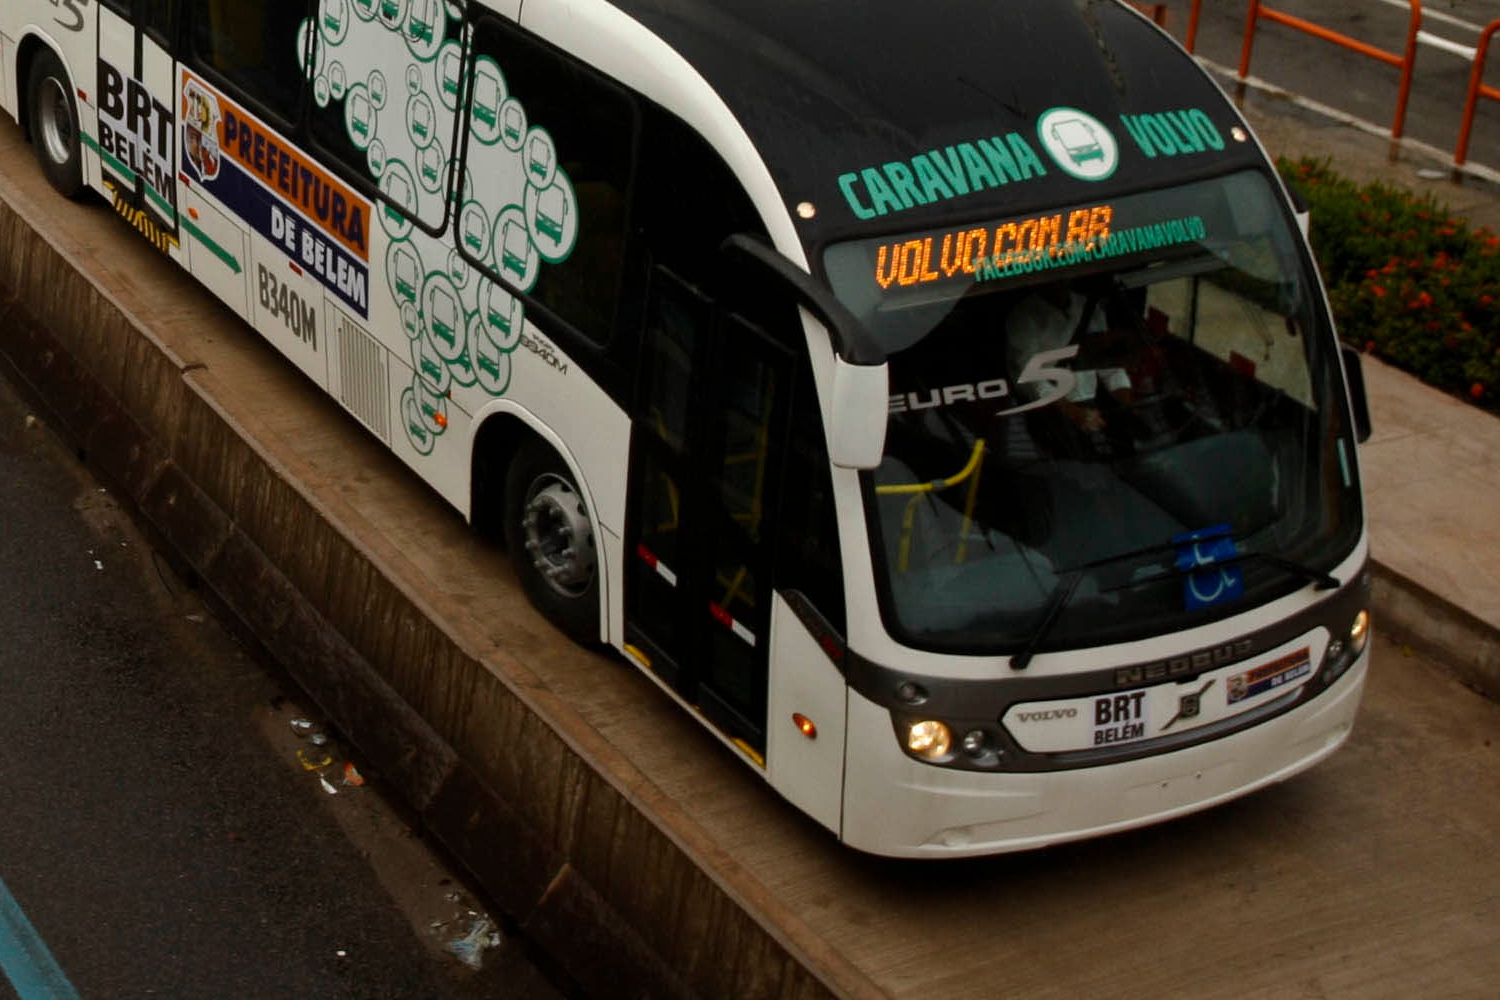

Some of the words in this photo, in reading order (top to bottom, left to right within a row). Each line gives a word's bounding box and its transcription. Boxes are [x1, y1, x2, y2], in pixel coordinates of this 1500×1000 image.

[99, 57, 175, 163] BRT
[99, 120, 175, 206] BELÉM
[223, 109, 366, 252] PREFEITURA
[837, 131, 1048, 221] CARAVANA
[1120, 107, 1226, 159] VOLVO
[270, 204, 297, 253] DE
[258, 261, 318, 353] B340M
[887, 377, 1010, 415] EURO
[995, 343, 1081, 417] 5
[1016, 707, 1079, 724] VOLVO
[1093, 690, 1148, 729] BRT
[1093, 721, 1146, 747] BELÉM
